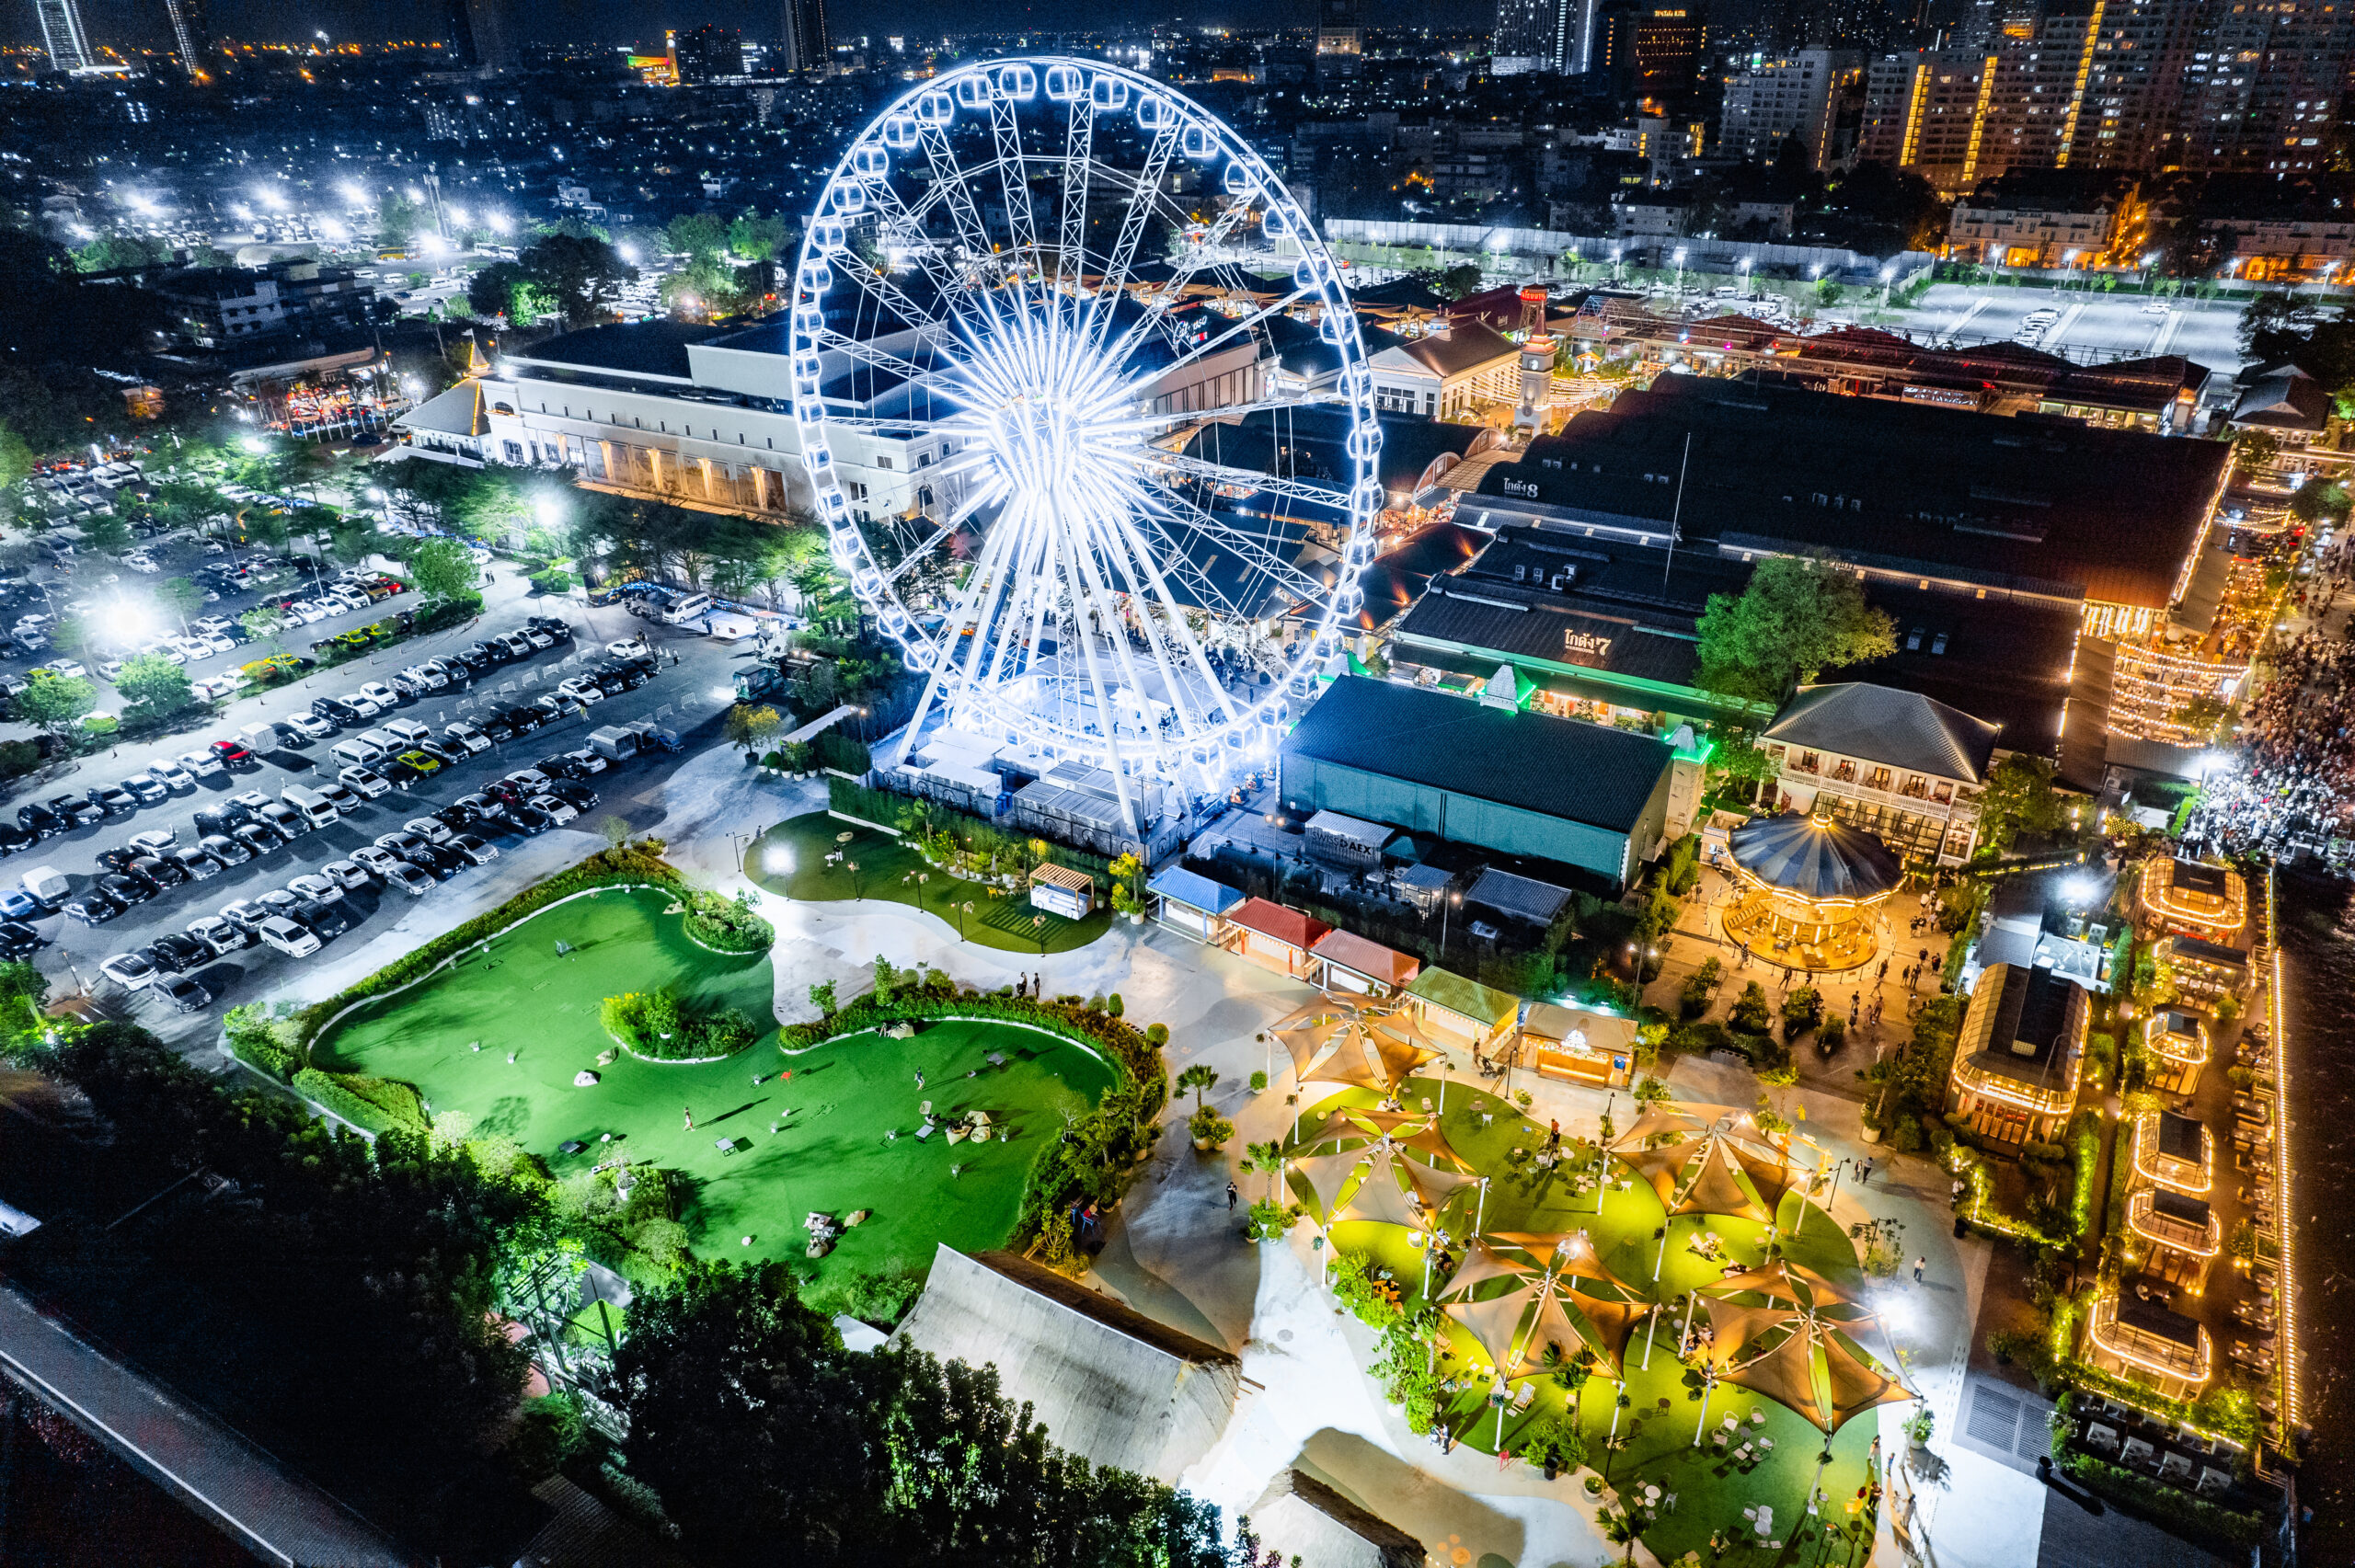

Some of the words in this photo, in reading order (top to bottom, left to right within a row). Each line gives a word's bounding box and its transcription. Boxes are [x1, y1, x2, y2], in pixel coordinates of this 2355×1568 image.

[1504, 478, 1526, 493] โกดัง
[1527, 484, 1538, 498] 8
[1565, 629, 1594, 648] โกดัง
[1596, 637, 1612, 656] 7
